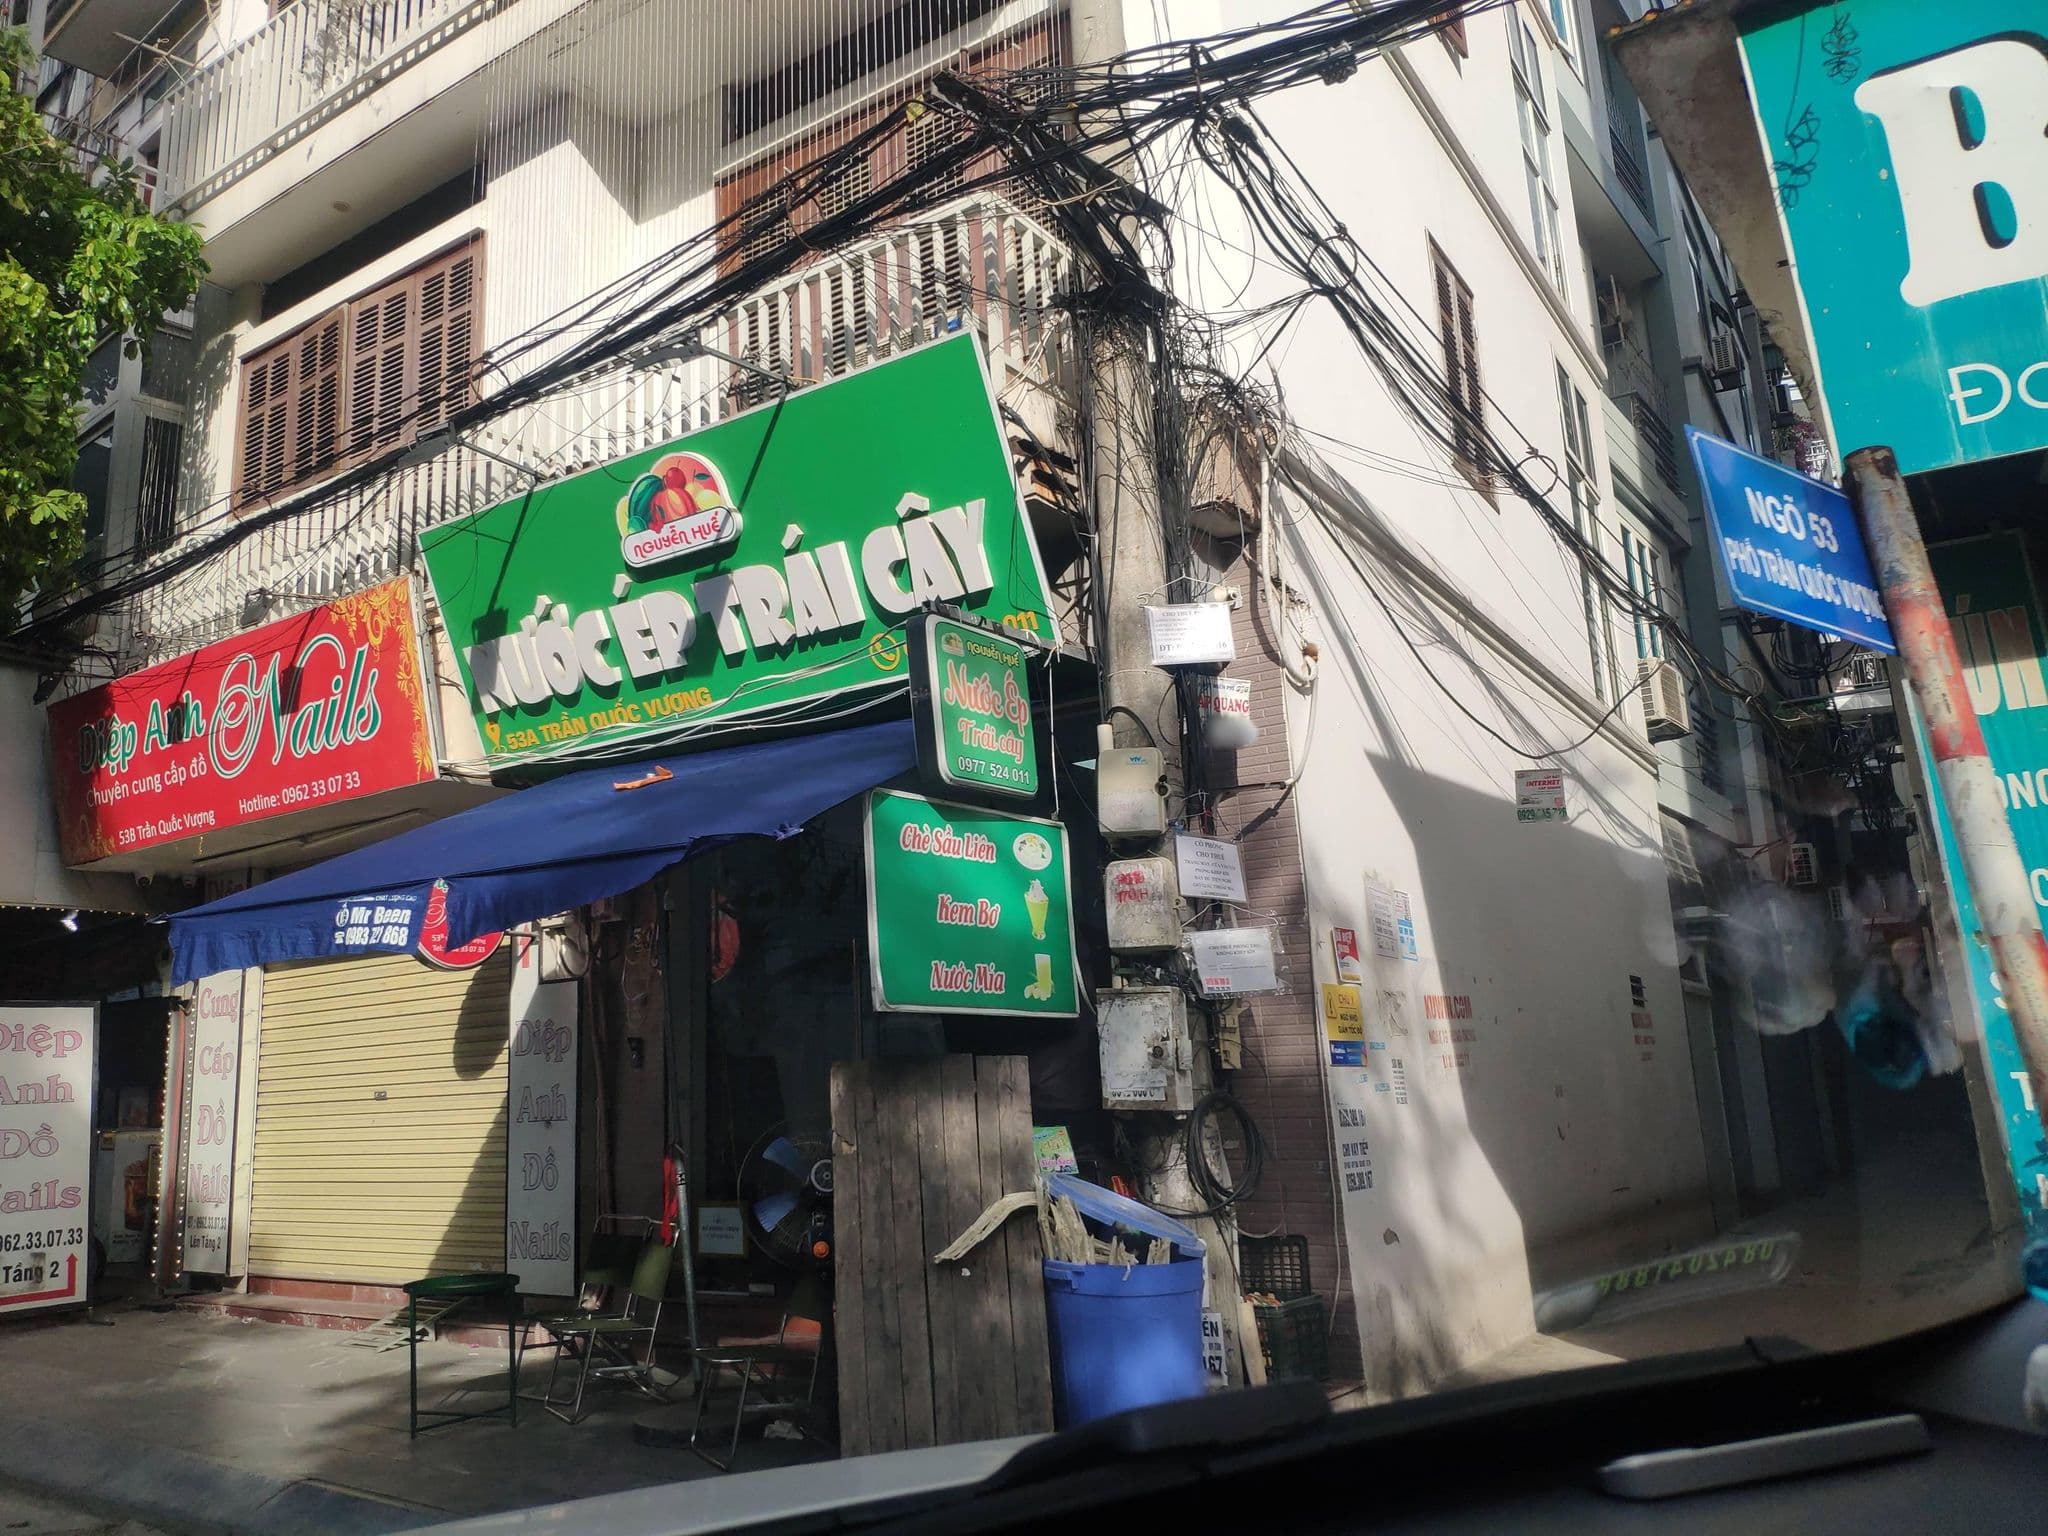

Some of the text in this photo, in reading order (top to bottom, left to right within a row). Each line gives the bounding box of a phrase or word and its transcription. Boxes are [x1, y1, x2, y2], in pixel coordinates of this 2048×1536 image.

[634, 511, 721, 558] NGUYỄN HUẾ
[1744, 486, 1839, 553] NGÕ 53
[1724, 537, 1762, 578] PHỐ
[1757, 548, 1802, 592] TRẦN
[1798, 563, 1842, 605] QUỐC
[462, 492, 994, 714] NƯỚC ÉP TRÁI CÂY
[209, 633, 382, 780] Nails
[944, 659, 1028, 737] Nước Ép
[1213, 696, 1249, 713] QUANG
[79, 690, 206, 776] Diệp Anh
[506, 729, 539, 751] 53A
[539, 712, 587, 742] TRẦN
[591, 697, 642, 733] QUỐC
[958, 717, 998, 750] Trái
[132, 774, 162, 793] cung
[164, 760, 187, 786] cấp
[190, 752, 207, 777] đồ
[958, 756, 1030, 784] 0977 524 011
[1526, 779, 1560, 787] INTERNET
[239, 771, 360, 814] Hotline: 0962 33 07 33
[119, 811, 216, 846] 53B Trần Quốc Vượng
[901, 823, 996, 863] Chè Sầu Liên
[350, 906, 411, 924] Mr Been
[937, 894, 1000, 928] Kem Bơ
[381, 925, 409, 946] 868
[930, 961, 1005, 994] Nước Mía
[200, 987, 239, 1023] Cung
[199, 1041, 234, 1080] Cấp
[515, 1018, 571, 1063] Diệp
[197, 1098, 227, 1146] Đồ
[516, 1083, 568, 1124] Anh
[188, 1162, 229, 1204] Nails
[523, 1145, 559, 1191] Đồ
[0, 1179, 82, 1213] ails
[217, 1236, 222, 1249] 2
[509, 1220, 571, 1262] Nails
[3, 1261, 60, 1284] Tầng 2
